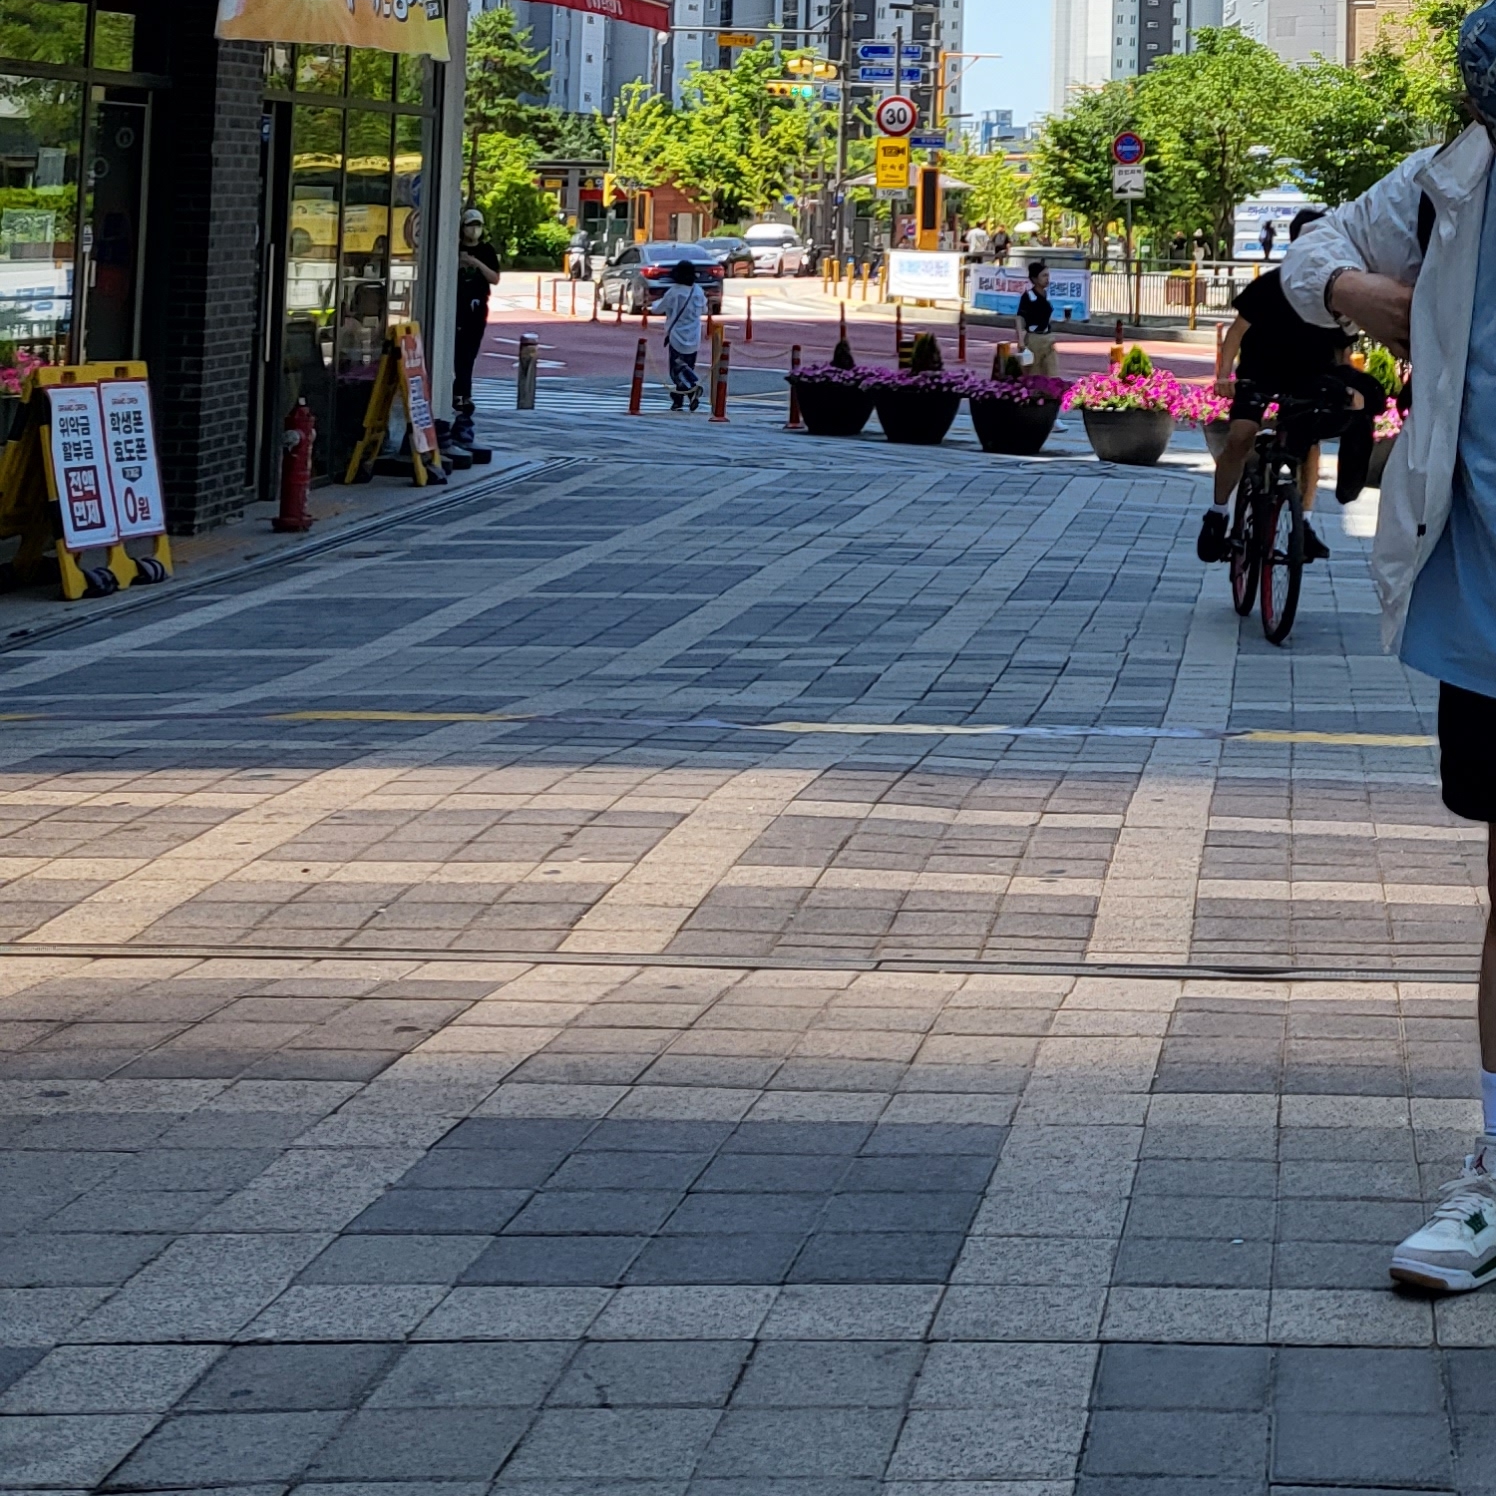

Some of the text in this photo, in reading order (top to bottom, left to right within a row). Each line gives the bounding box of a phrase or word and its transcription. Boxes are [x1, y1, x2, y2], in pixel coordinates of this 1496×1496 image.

[886, 107, 907, 126] 30
[59, 416, 91, 438] 위약금
[109, 411, 145, 435] 학생폰
[62, 440, 94, 461] 할부금
[113, 438, 148, 462] 효도폰
[69, 470, 97, 497] 전액
[73, 499, 102, 527] 면제
